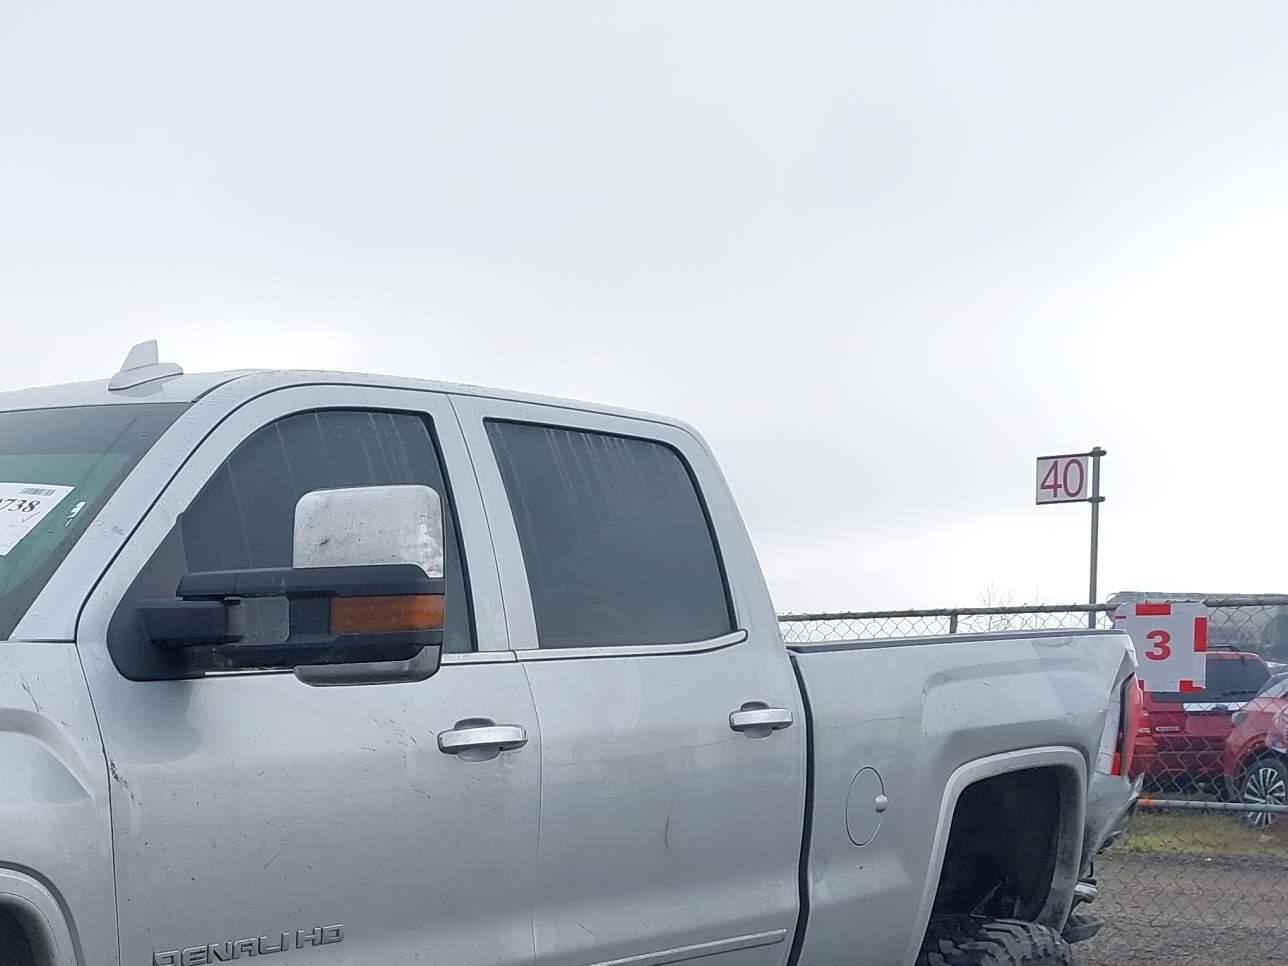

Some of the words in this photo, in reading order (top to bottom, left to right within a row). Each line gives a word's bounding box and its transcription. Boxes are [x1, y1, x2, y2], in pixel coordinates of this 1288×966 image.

[1039, 458, 1085, 499] 40
[1144, 629, 1172, 661] 3
[296, 923, 345, 949] HD
